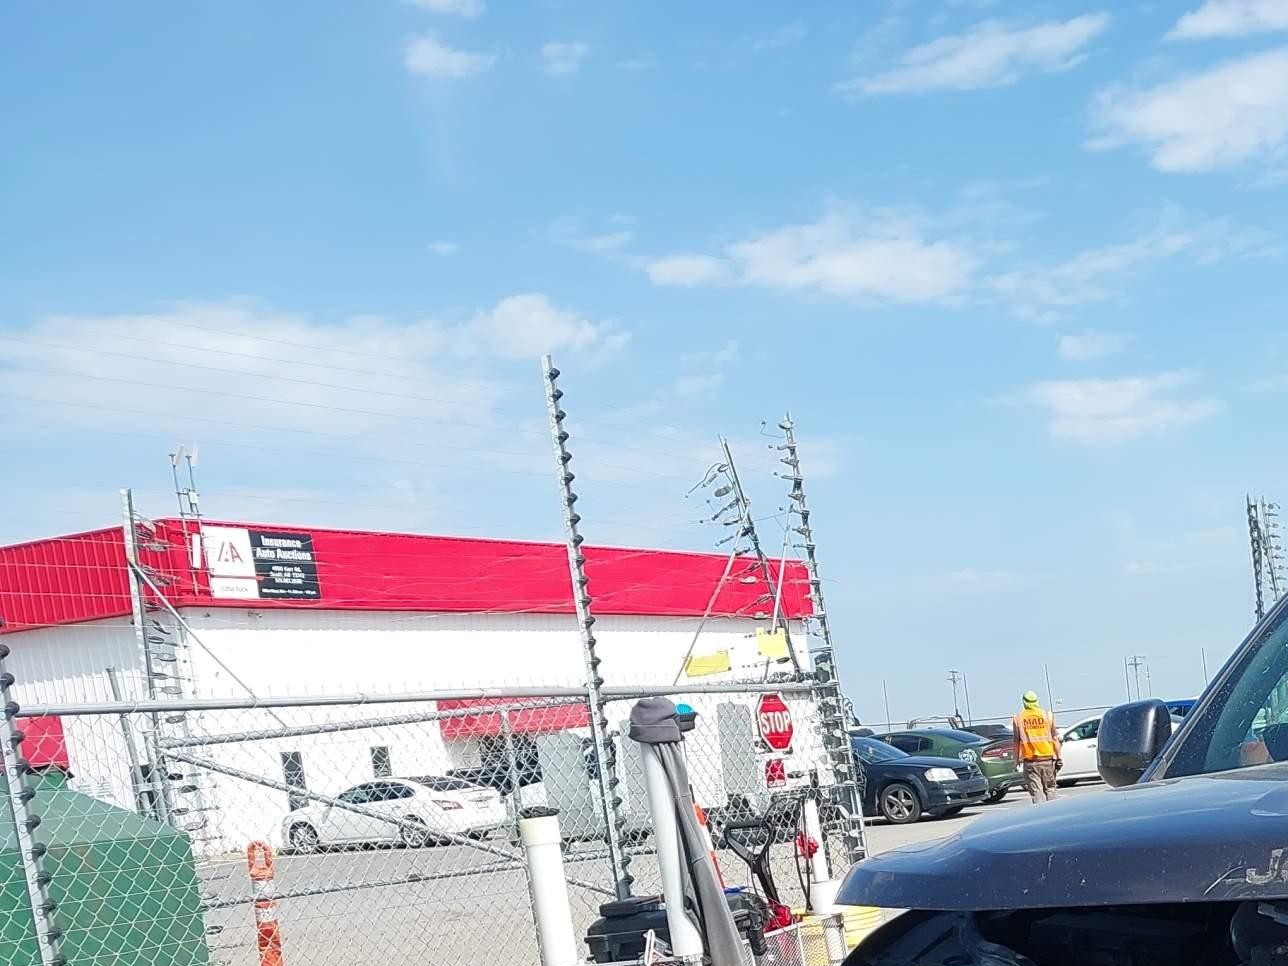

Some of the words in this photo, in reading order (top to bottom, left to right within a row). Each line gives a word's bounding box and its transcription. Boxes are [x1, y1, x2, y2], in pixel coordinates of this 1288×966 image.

[260, 535, 302, 549] Insurance
[256, 547, 276, 559] Auto
[277, 548, 312, 561] Auctions
[760, 710, 791, 734] STOP
